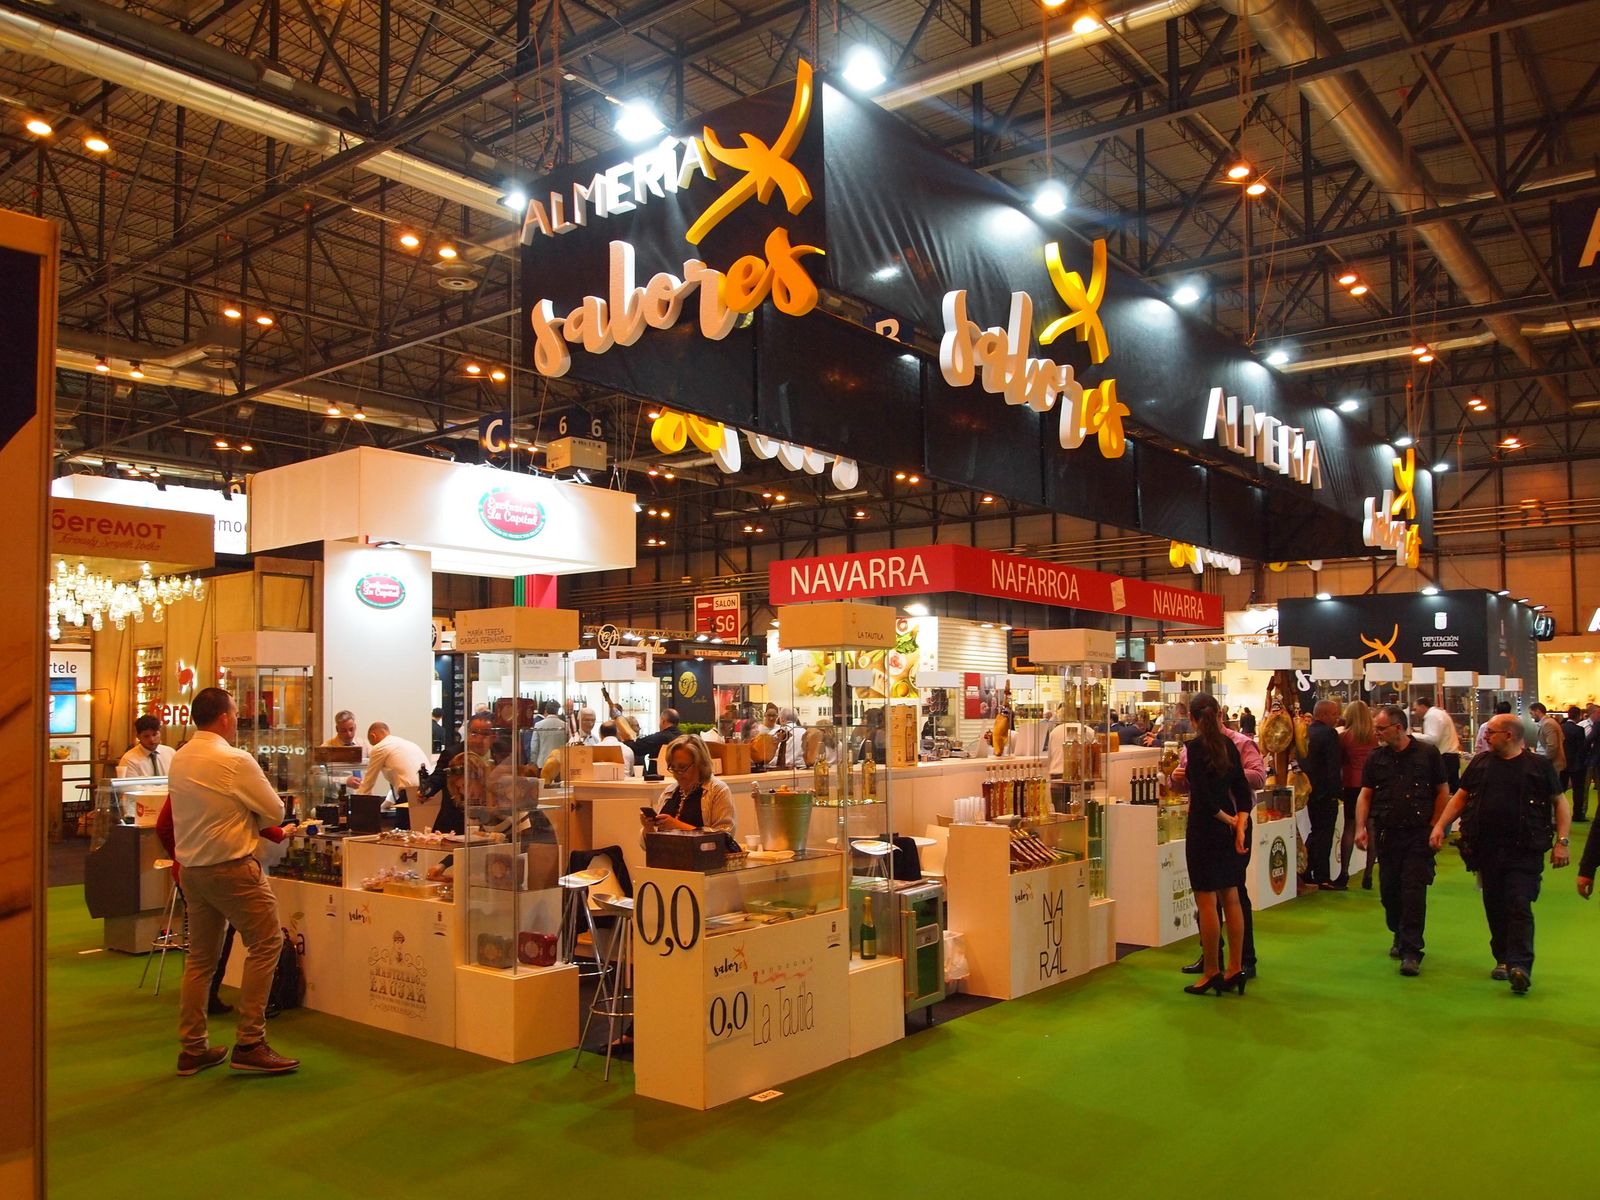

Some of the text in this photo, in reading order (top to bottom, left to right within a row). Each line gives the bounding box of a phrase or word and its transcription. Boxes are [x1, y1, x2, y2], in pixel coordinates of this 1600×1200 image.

[531, 226, 826, 378] sabores
[939, 289, 1131, 459] sabores
[485, 418, 503, 453] C
[559, 415, 568, 435] 6
[591, 418, 602, 437] 6
[789, 553, 930, 597] NAVARRA
[990, 557, 1081, 602] NAFARROA
[715, 598, 736, 608] SALÓN
[1152, 588, 1205, 621] NAVARRA
[485, 628, 505, 636] TERESA
[715, 614, 735, 633] SG
[857, 631, 885, 641] LA TAUTILA
[1421, 635, 1460, 643] DIPUTACIÓN
[1431, 640, 1459, 648] ALMERÍA
[636, 881, 700, 957] 0,0
[1042, 888, 1064, 921] NA
[1044, 917, 1063, 950] TU
[1039, 946, 1068, 981] RAL
[709, 990, 749, 1039] 0,0
[753, 980, 815, 1047] La Tautila
